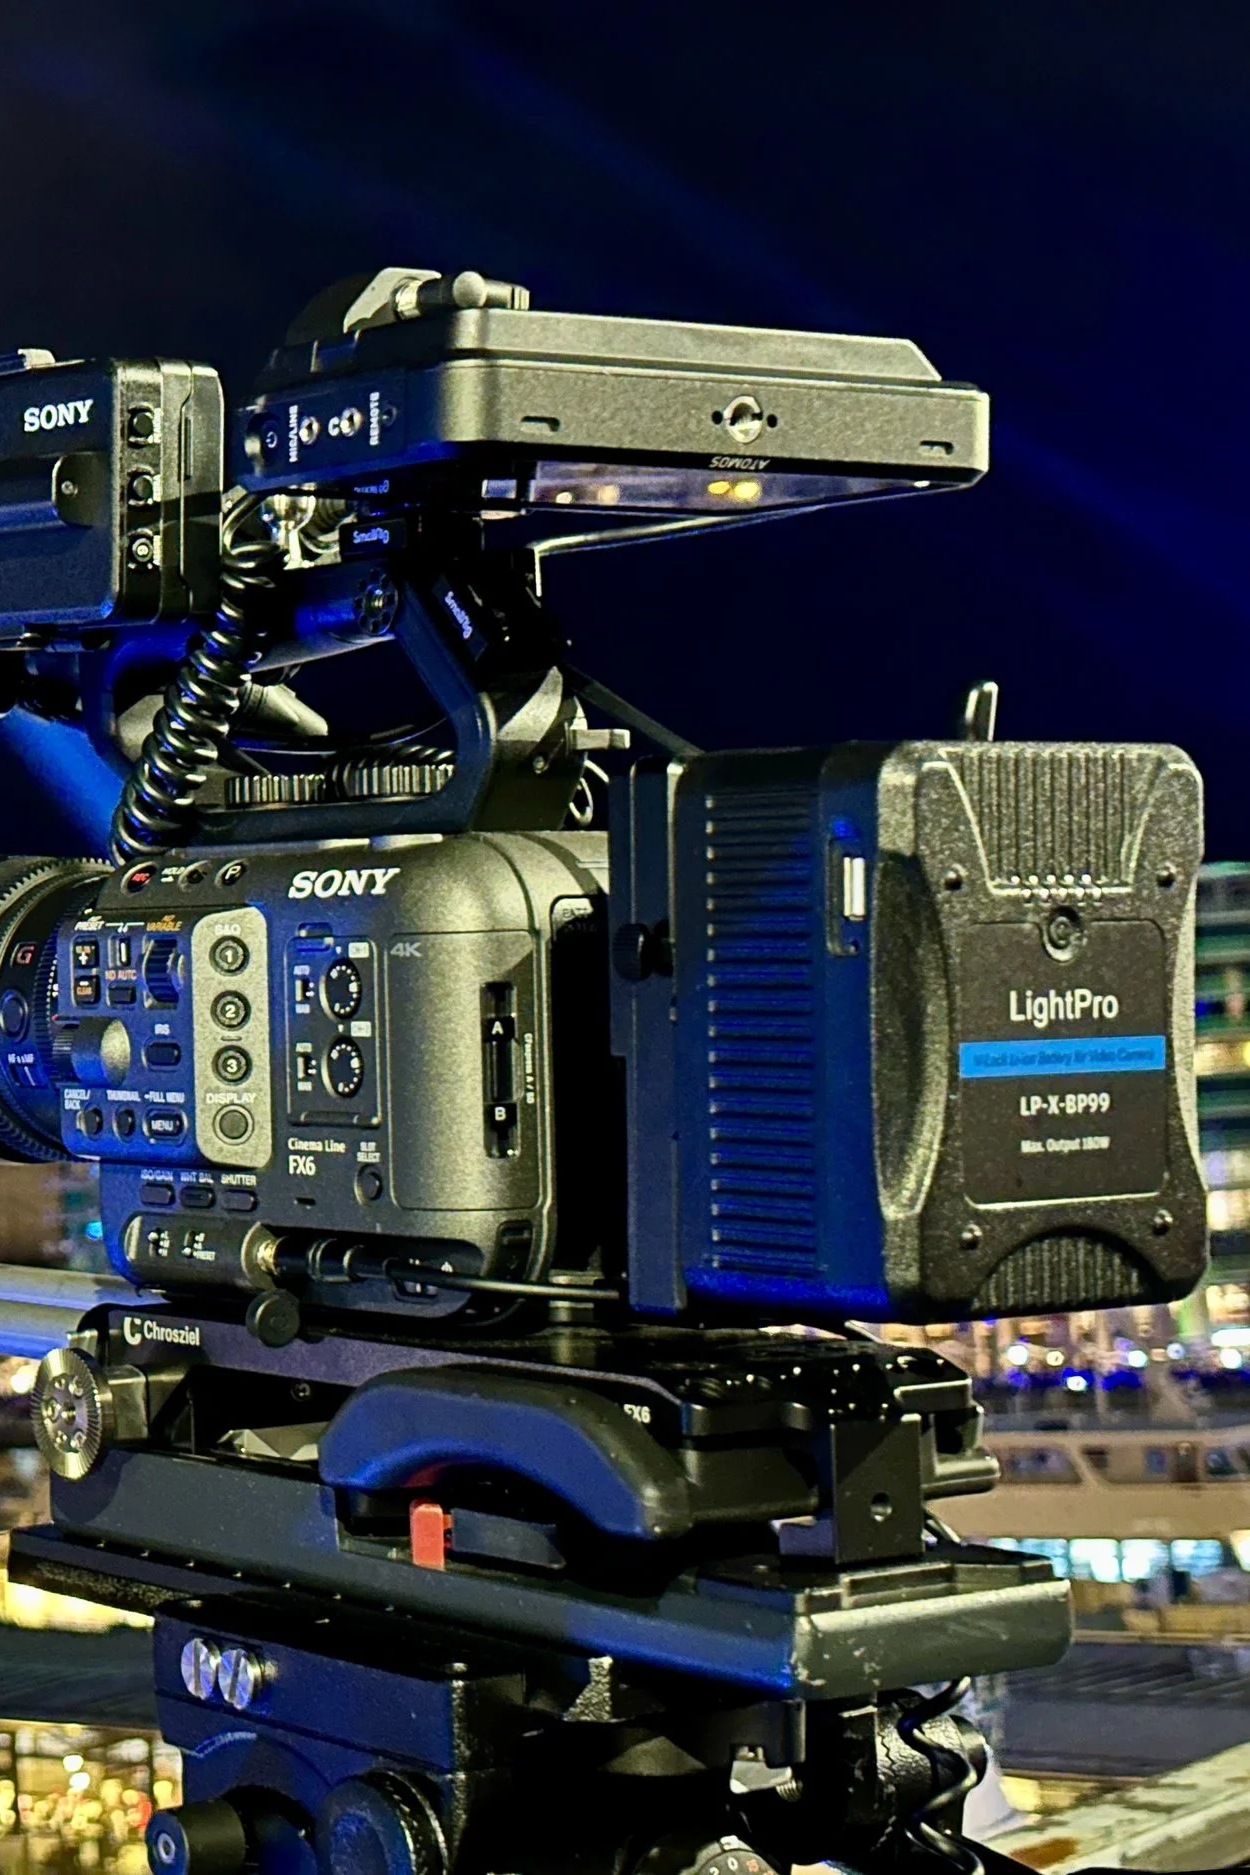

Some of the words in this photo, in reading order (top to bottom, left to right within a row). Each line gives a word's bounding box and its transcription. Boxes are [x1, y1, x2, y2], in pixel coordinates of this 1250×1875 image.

[23, 400, 94, 433] SONY
[369, 391, 380, 446] REMOTE
[709, 456, 771, 470] ATOMOS
[288, 868, 401, 900] SONY
[225, 951, 234, 964] 1
[390, 942, 423, 958] 4K
[225, 1004, 236, 1018] 2
[1009, 988, 1120, 1029] LightPro
[491, 1021, 504, 1035] A
[226, 1058, 238, 1073] 3
[206, 1093, 257, 1104] DISPLAY
[1020, 1092, 1111, 1117] LP-X-BP99
[494, 1107, 506, 1121] B
[151, 1120, 174, 1131] MENU
[287, 1138, 323, 1151] Cinema
[324, 1139, 346, 1153] Line
[288, 1154, 316, 1176] FX6
[221, 1174, 257, 1186] SHUTTER
[143, 1320, 200, 1346] Chrosziel
[623, 1403, 651, 1424] FX6
